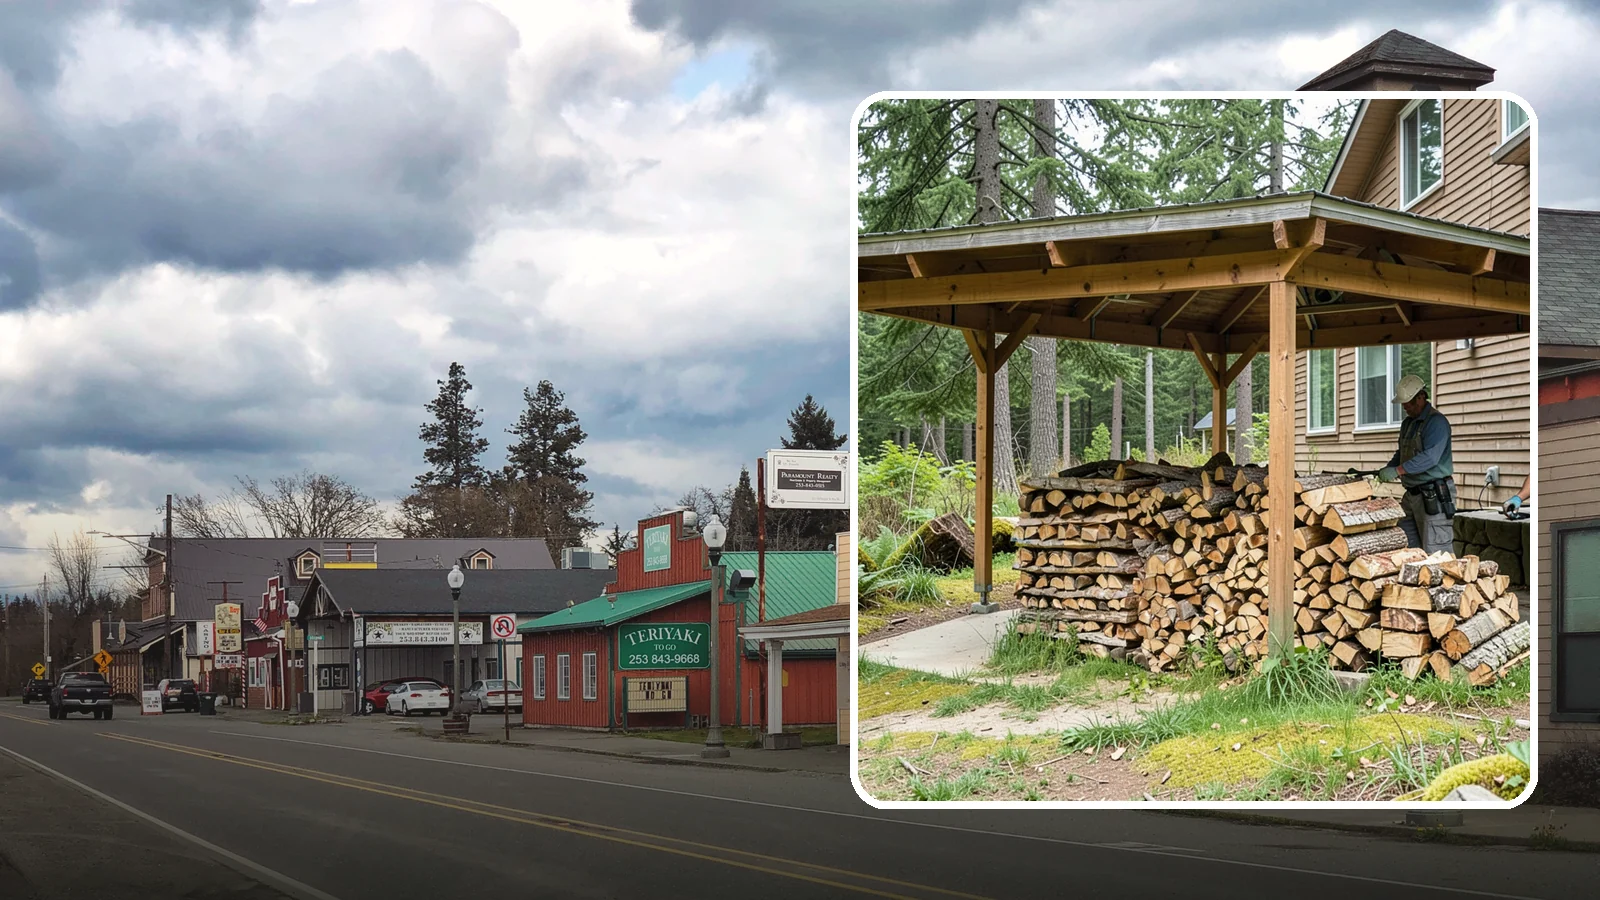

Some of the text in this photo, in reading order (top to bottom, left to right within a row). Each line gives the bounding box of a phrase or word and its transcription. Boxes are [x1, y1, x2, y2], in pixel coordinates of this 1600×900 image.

[625, 628, 702, 646] TERIYAKI
[629, 654, 700, 664] 253 843-9668
[639, 681, 672, 690] TERIYAKI
